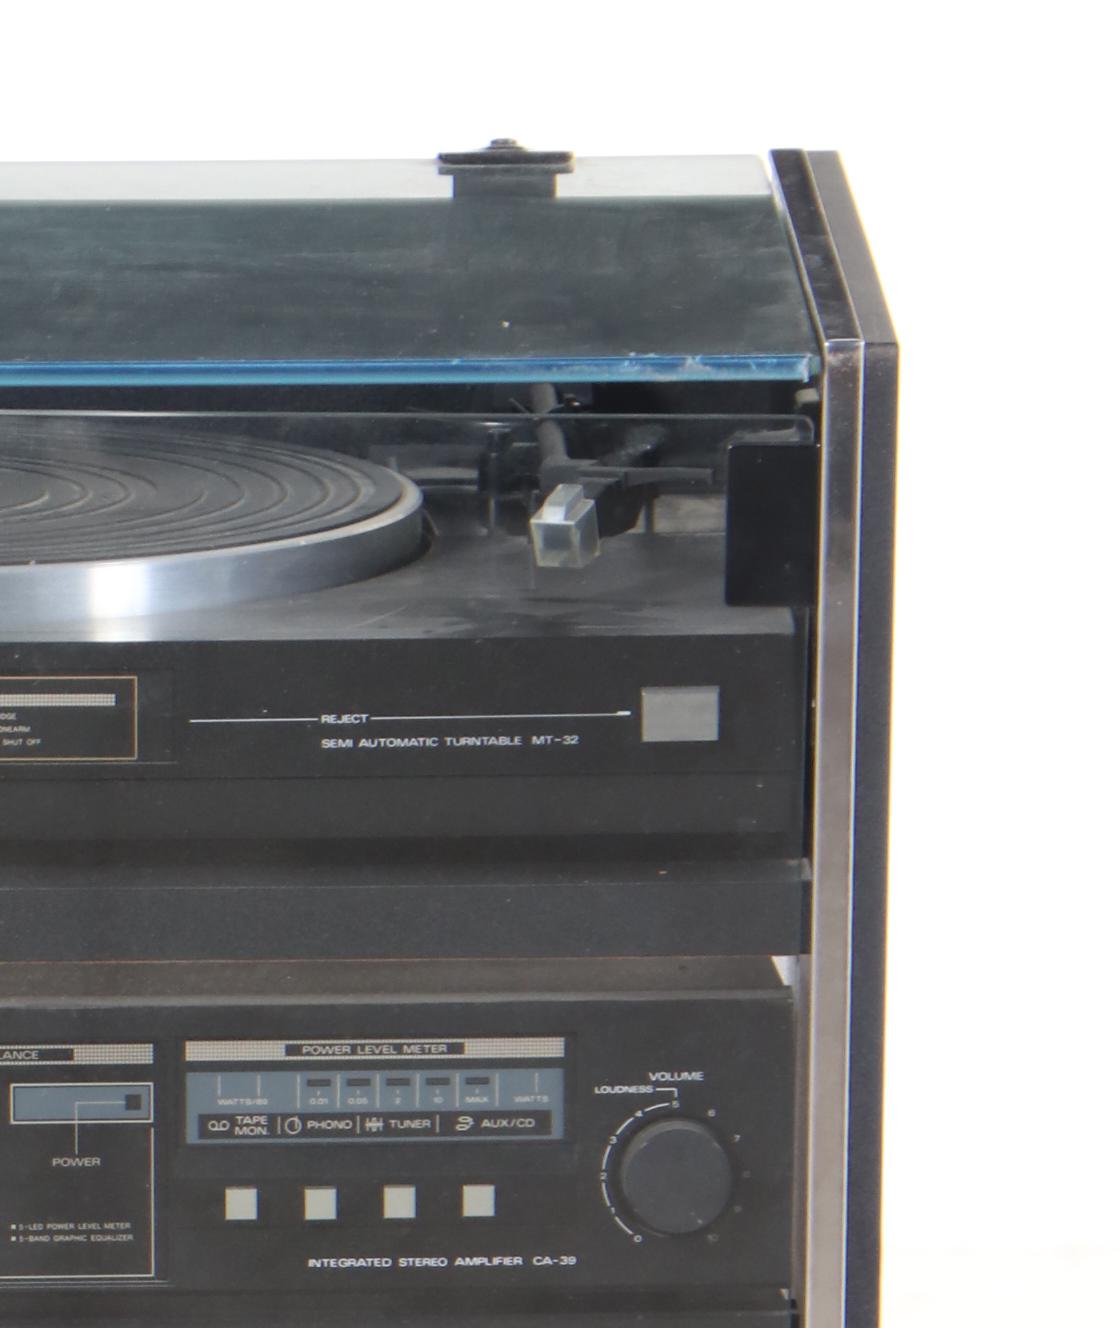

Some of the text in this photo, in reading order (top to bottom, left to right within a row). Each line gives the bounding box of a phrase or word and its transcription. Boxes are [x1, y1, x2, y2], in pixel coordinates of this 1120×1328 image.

[321, 714, 368, 724] REJECT
[322, 735, 578, 748] SEMI AUTOMATIC TURNTABLE MT-32
[301, 1044, 447, 1055] POWER LEVEL METER
[649, 1072, 703, 1081] VOLUME
[595, 1085, 653, 1093] LOUDNESS
[236, 1116, 268, 1127] TAPE
[307, 1120, 352, 1129] PHONO
[389, 1119, 431, 1128] TUNER
[481, 1118, 535, 1128] AUX/CD
[235, 1123, 269, 1135] MON.
[52, 1157, 100, 1167] POWER
[308, 1256, 576, 1267] INTEGRATED STEREO AMPLIFIER CA-39
